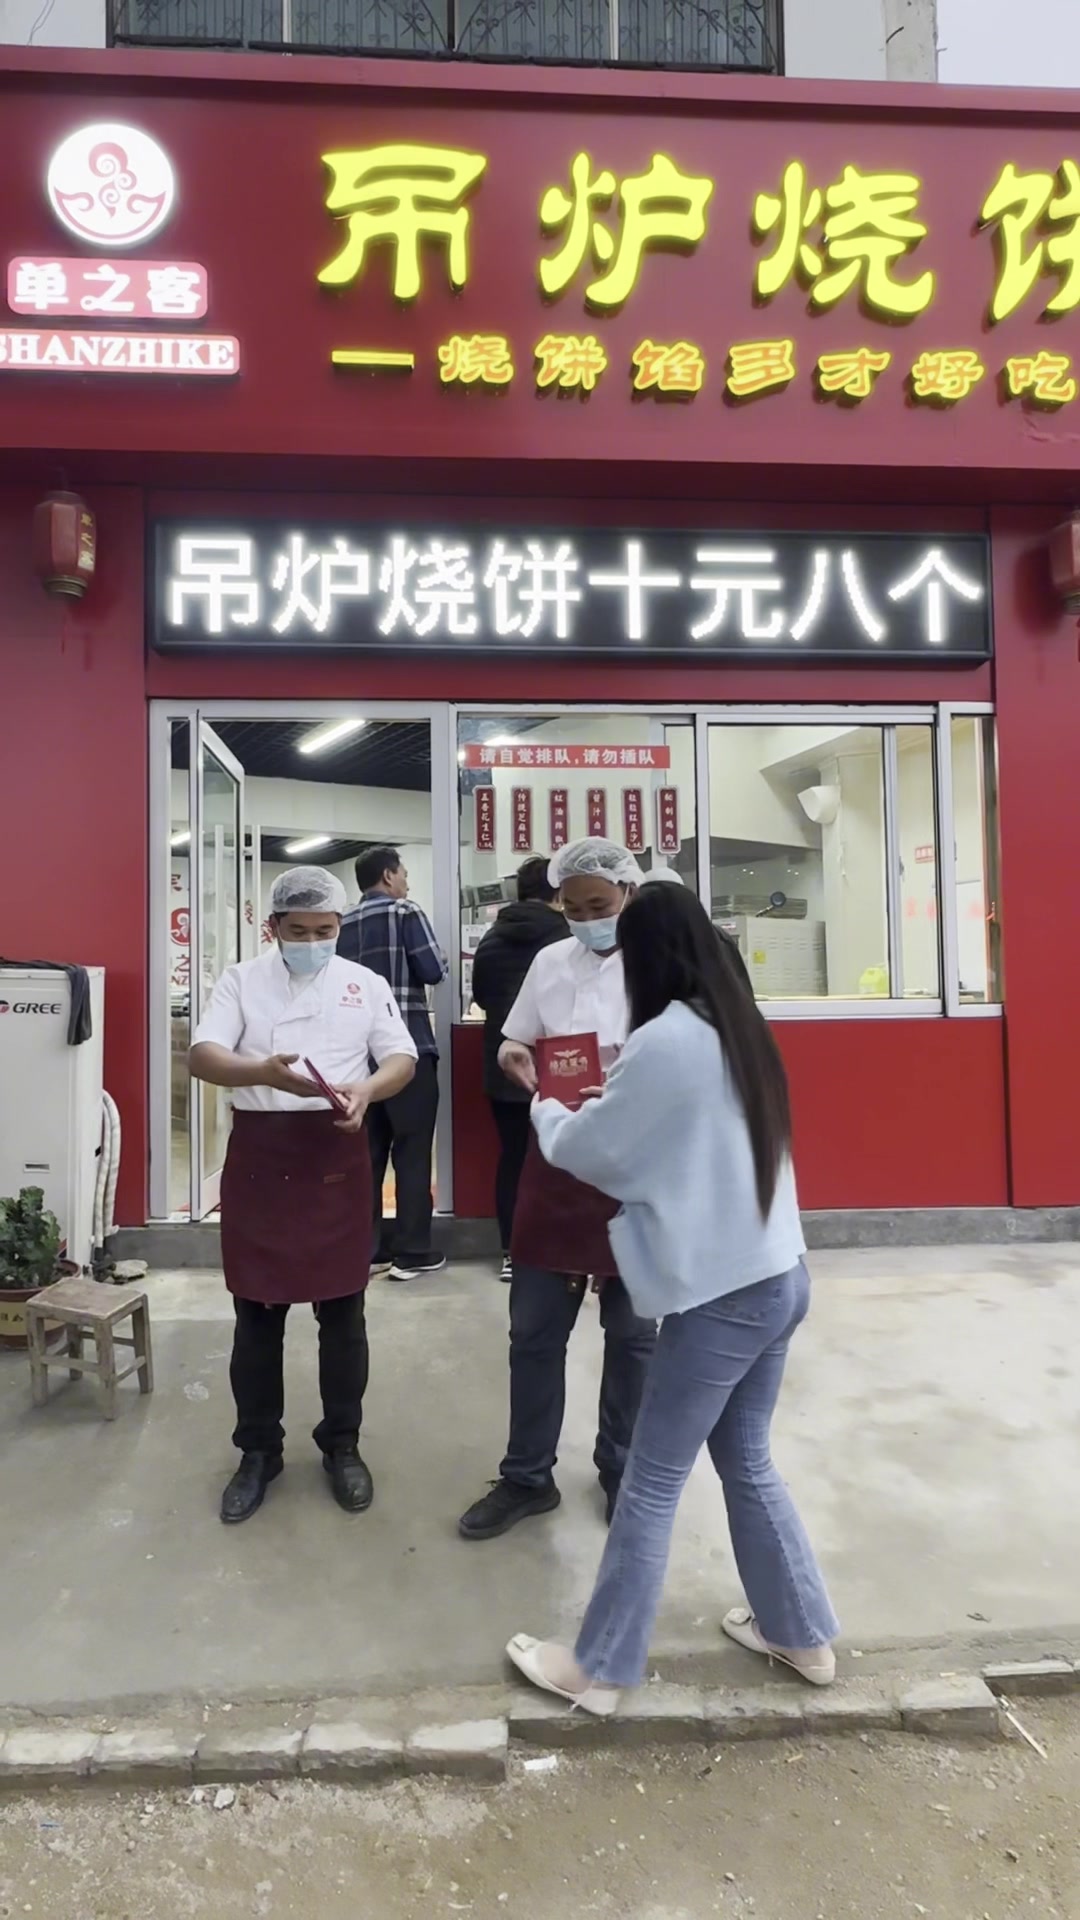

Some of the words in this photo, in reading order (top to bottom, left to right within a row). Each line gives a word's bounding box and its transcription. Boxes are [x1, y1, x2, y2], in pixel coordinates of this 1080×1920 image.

[317, 143, 1080, 320] 吊炉烧饼
[14, 261, 202, 315] 单之客
[168, 532, 983, 643] 吊炉烧饼十元八个
[12, 1002, 62, 1014] GREE
